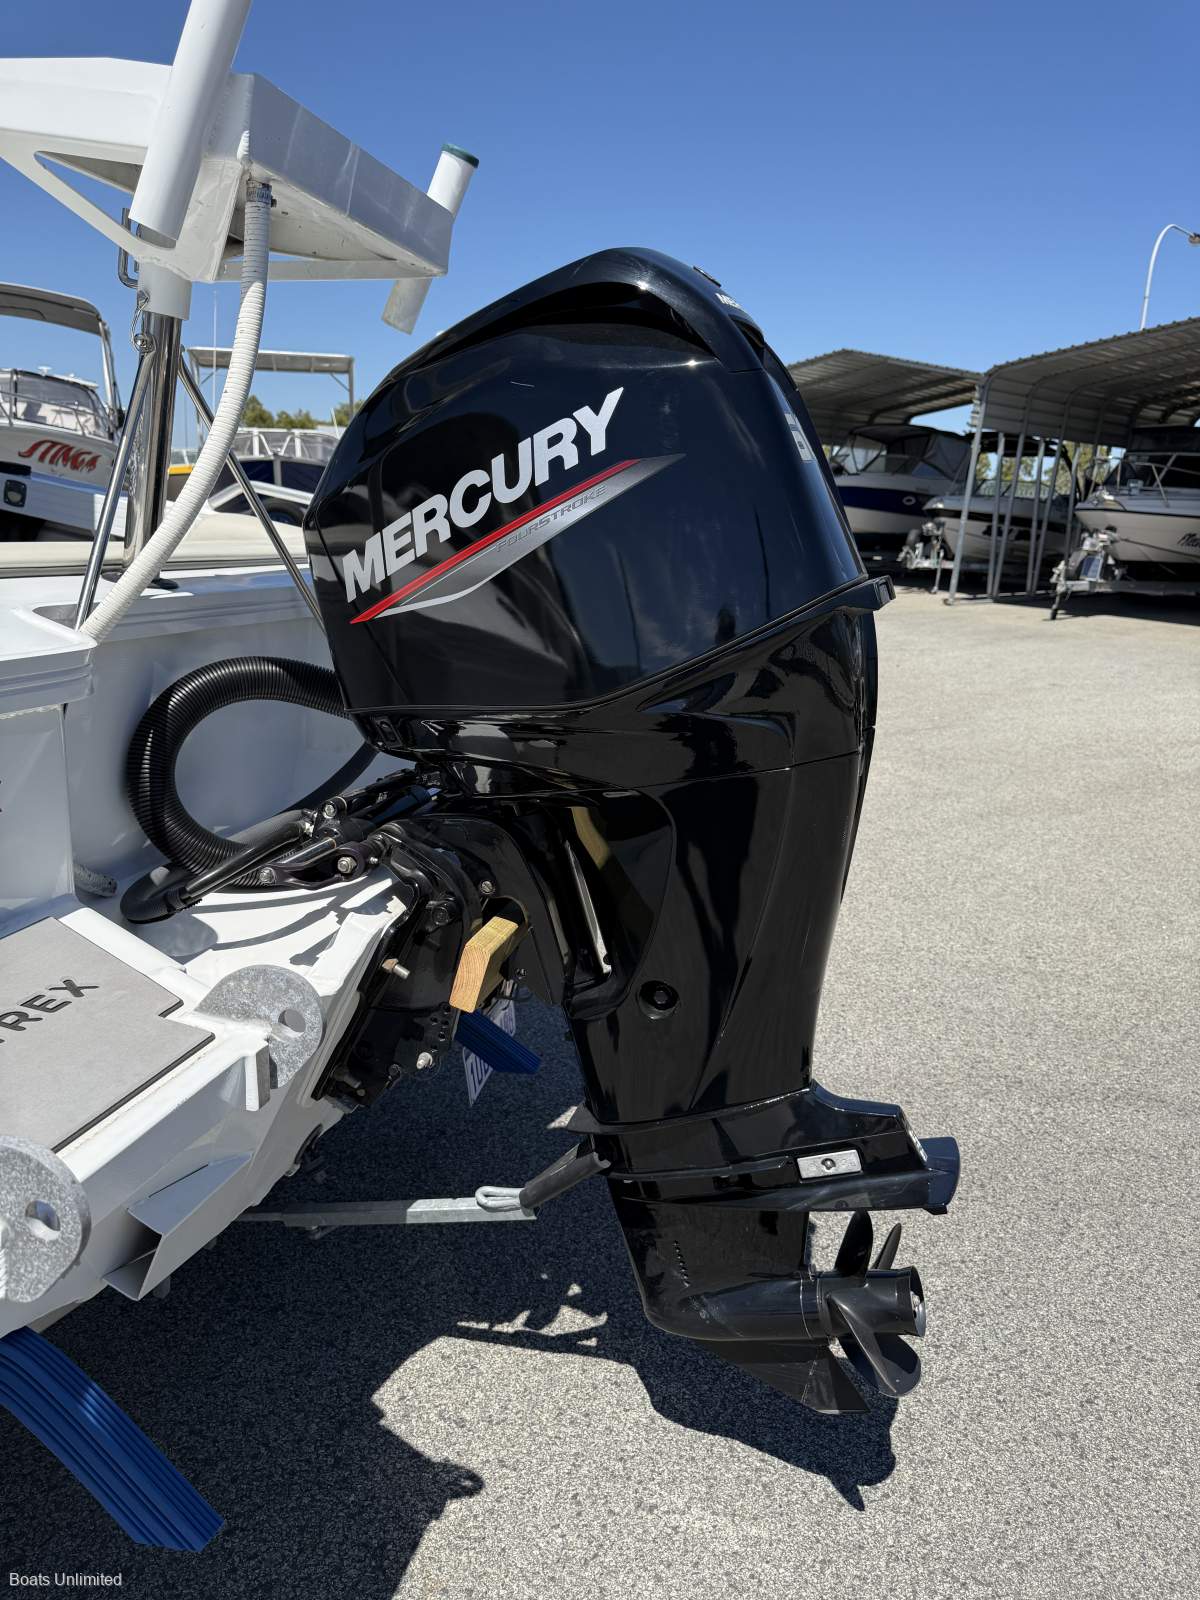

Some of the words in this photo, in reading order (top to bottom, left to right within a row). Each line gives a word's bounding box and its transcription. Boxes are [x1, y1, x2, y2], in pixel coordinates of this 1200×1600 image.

[342, 386, 624, 603] MERCURY
[496, 483, 608, 553] FOURSTROKE
[0, 979, 99, 1044] REX
